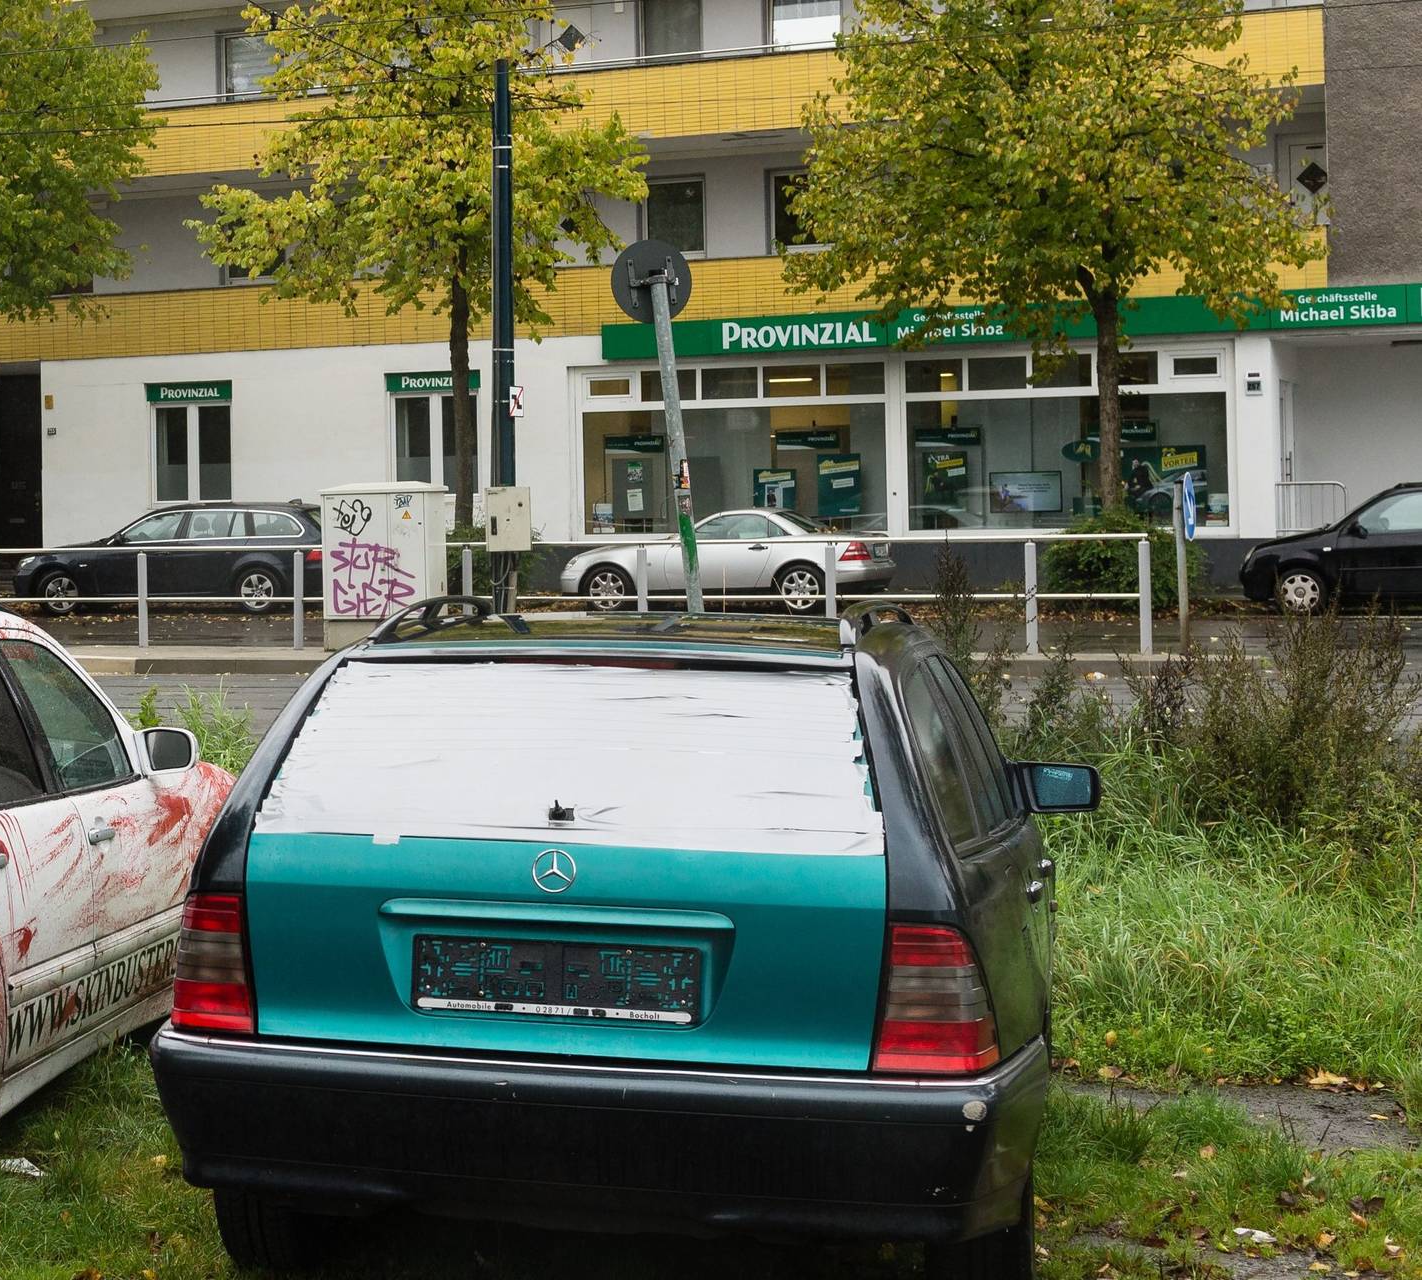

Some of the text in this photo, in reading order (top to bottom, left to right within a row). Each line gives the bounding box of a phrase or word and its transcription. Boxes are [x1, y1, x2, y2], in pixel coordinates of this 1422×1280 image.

[1297, 291, 1378, 304] Gechäftsstelle
[1280, 304, 1397, 322] Michael Skiba
[721, 320, 877, 349] PROVINZIAL
[401, 375, 453, 388] PROVINZI
[160, 386, 220, 399] PROVINZIAL
[1163, 456, 1197, 468] VORTEIL
[446, 1001, 492, 1010] Automobile
[629, 1011, 660, 1020] Bocholt
